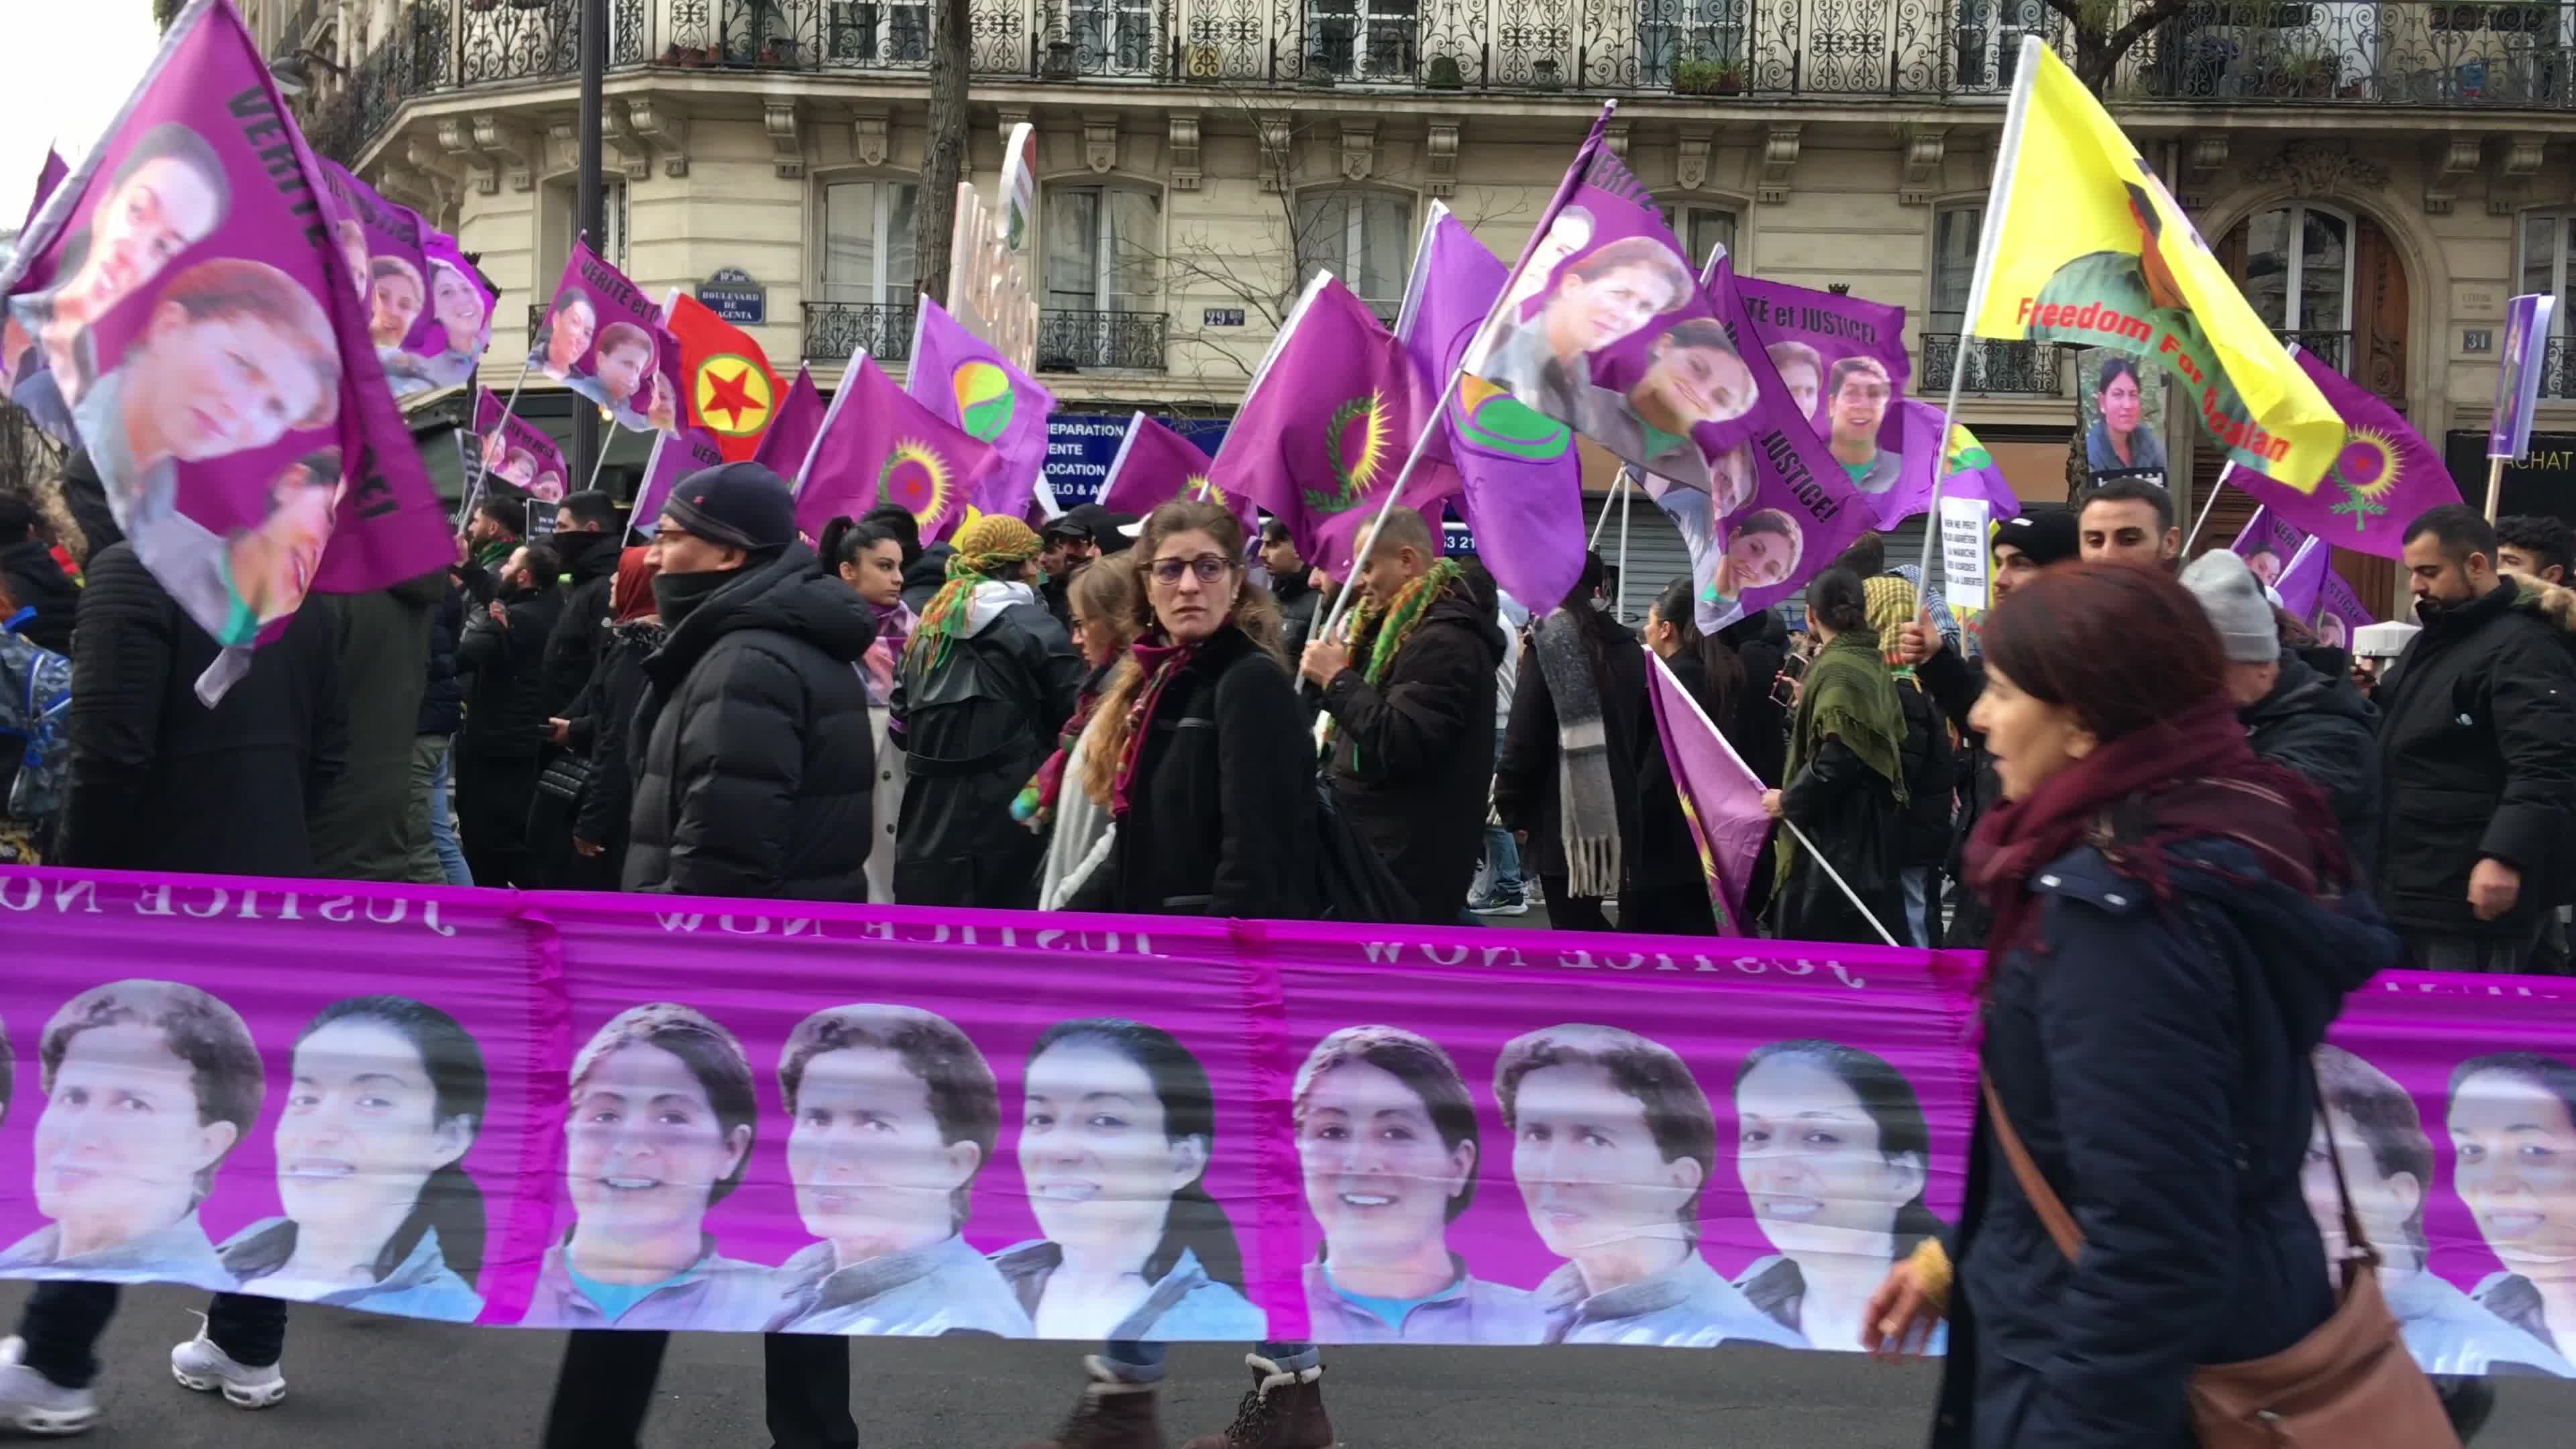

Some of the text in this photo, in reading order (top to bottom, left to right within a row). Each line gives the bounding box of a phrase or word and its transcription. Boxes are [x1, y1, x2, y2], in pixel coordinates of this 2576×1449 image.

[702, 292, 759, 301] BOULEVARD
[724, 301, 737, 309] DE
[718, 311, 752, 320] AGENTA
[1205, 311, 1226, 326] 29
[1774, 306, 1796, 328] et
[1801, 307, 1876, 344] JUSTICE!
[2017, 297, 2153, 343] Freedom
[2158, 333, 2204, 384] For
[2468, 333, 2485, 349] 31
[1049, 443, 1083, 455] ENTE
[1760, 429, 1839, 523] JUSTICE!
[1050, 483, 1074, 495] ELO
[1077, 484, 1086, 496] &
[1459, 536, 1475, 549] 21
